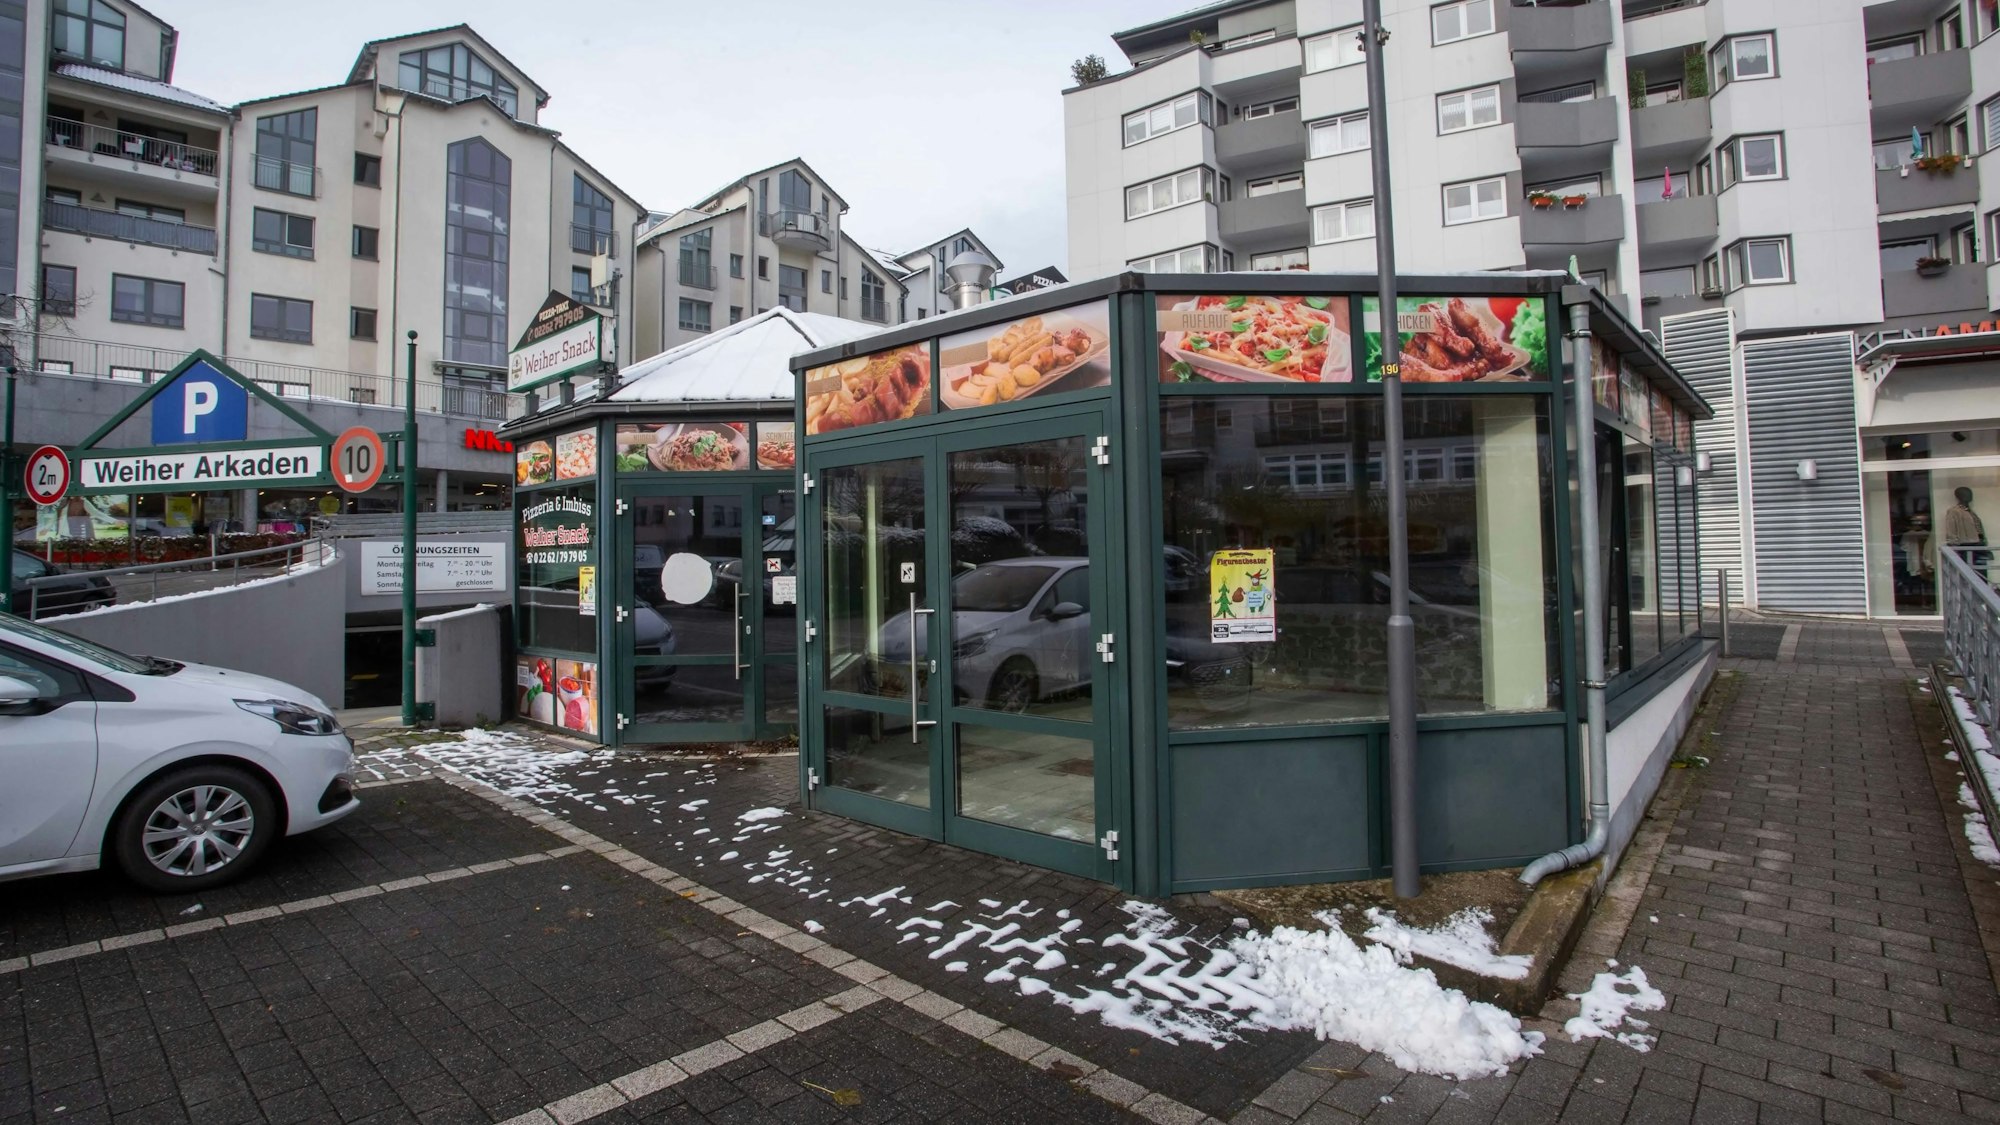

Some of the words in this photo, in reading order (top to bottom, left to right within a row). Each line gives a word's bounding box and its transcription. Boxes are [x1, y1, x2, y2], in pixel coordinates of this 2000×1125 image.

[539, 300, 570, 322] PIZZA-TAXI
[1182, 314, 1229, 329] AUFLAUF
[1397, 314, 1431, 329] HICKEN
[524, 350, 560, 375] Weiher
[562, 331, 596, 362] Snack
[1381, 364, 1399, 375] 190
[184, 381, 218, 434] P
[765, 431, 795, 441] SCHNITZE
[95, 459, 184, 483] Weiher
[194, 452, 309, 479] Arkaden
[346, 445, 371, 474] 10
[522, 498, 554, 523] Pizzeria
[555, 495, 561, 511] &
[562, 495, 592, 517] Imbiss
[523, 527, 557, 547] Weiher
[557, 523, 589, 545] Snack
[1216, 558, 1267, 566] Figurentheater
[455, 579, 494, 587] geschlossen
